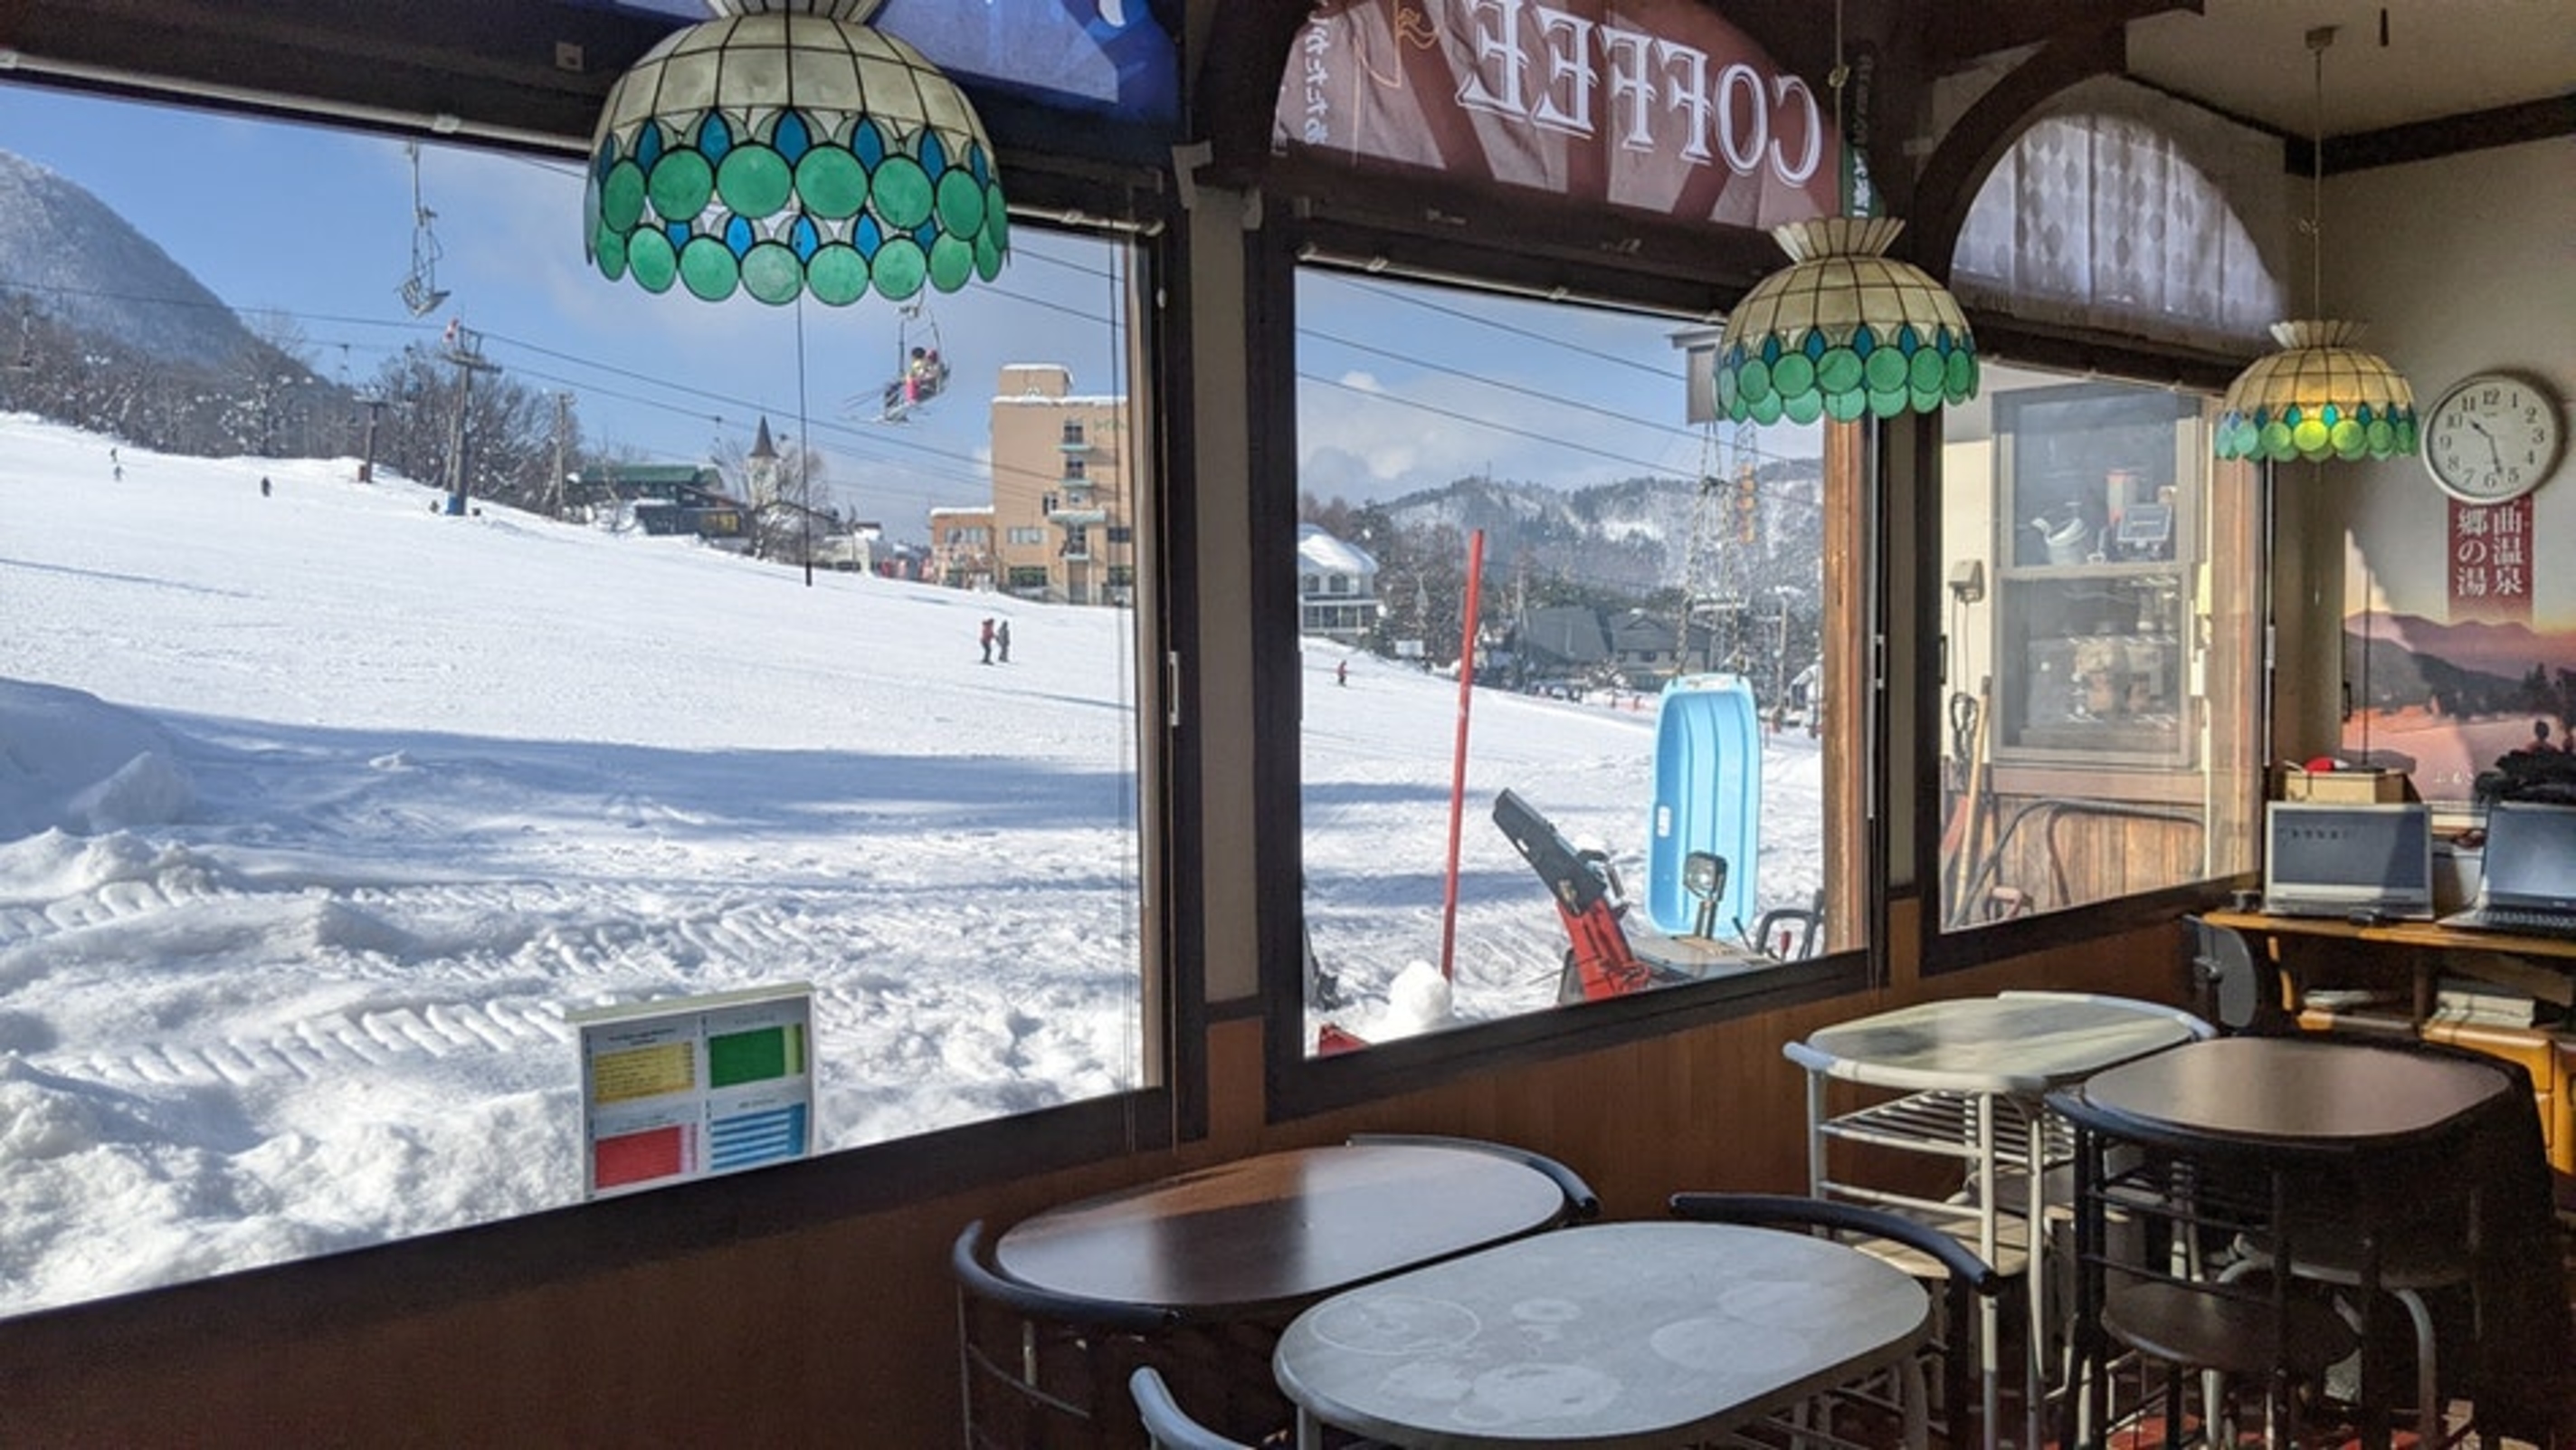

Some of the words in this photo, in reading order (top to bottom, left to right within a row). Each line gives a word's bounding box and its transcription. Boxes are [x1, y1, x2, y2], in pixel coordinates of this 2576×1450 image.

[2462, 396, 2476, 412] 11
[2483, 388, 2501, 405] 12
[2513, 392, 2518, 409] 1
[2446, 413, 2463, 428] 10
[2524, 406, 2537, 425] 2
[2532, 429, 2544, 444] 3
[2448, 455, 2460, 472] 8
[2464, 469, 2476, 484] 7
[2484, 472, 2497, 489] 6
[2507, 467, 2520, 483] 5
[2457, 507, 2488, 596] 郷の湯
[2493, 499, 2523, 596] 曲温泉
